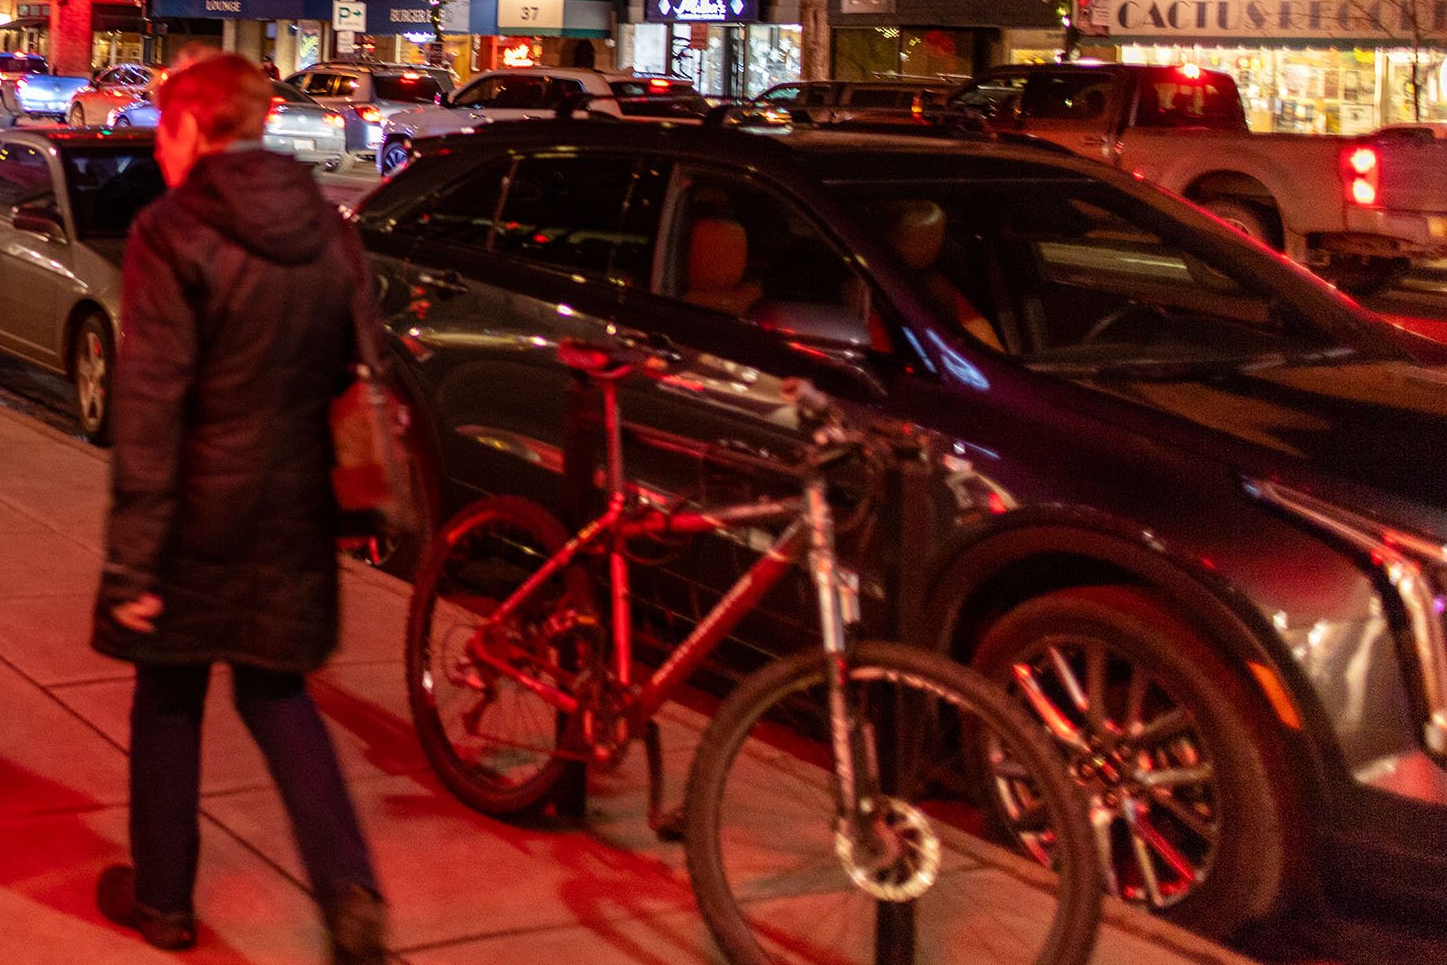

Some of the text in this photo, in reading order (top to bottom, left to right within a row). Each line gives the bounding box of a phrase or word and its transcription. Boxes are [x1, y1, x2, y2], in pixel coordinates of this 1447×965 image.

[206, 0, 242, 13] LOUNGE
[520, 6, 539, 21] 37
[390, 8, 426, 23] BURGER
[1118, 0, 1266, 31] CACTUS
